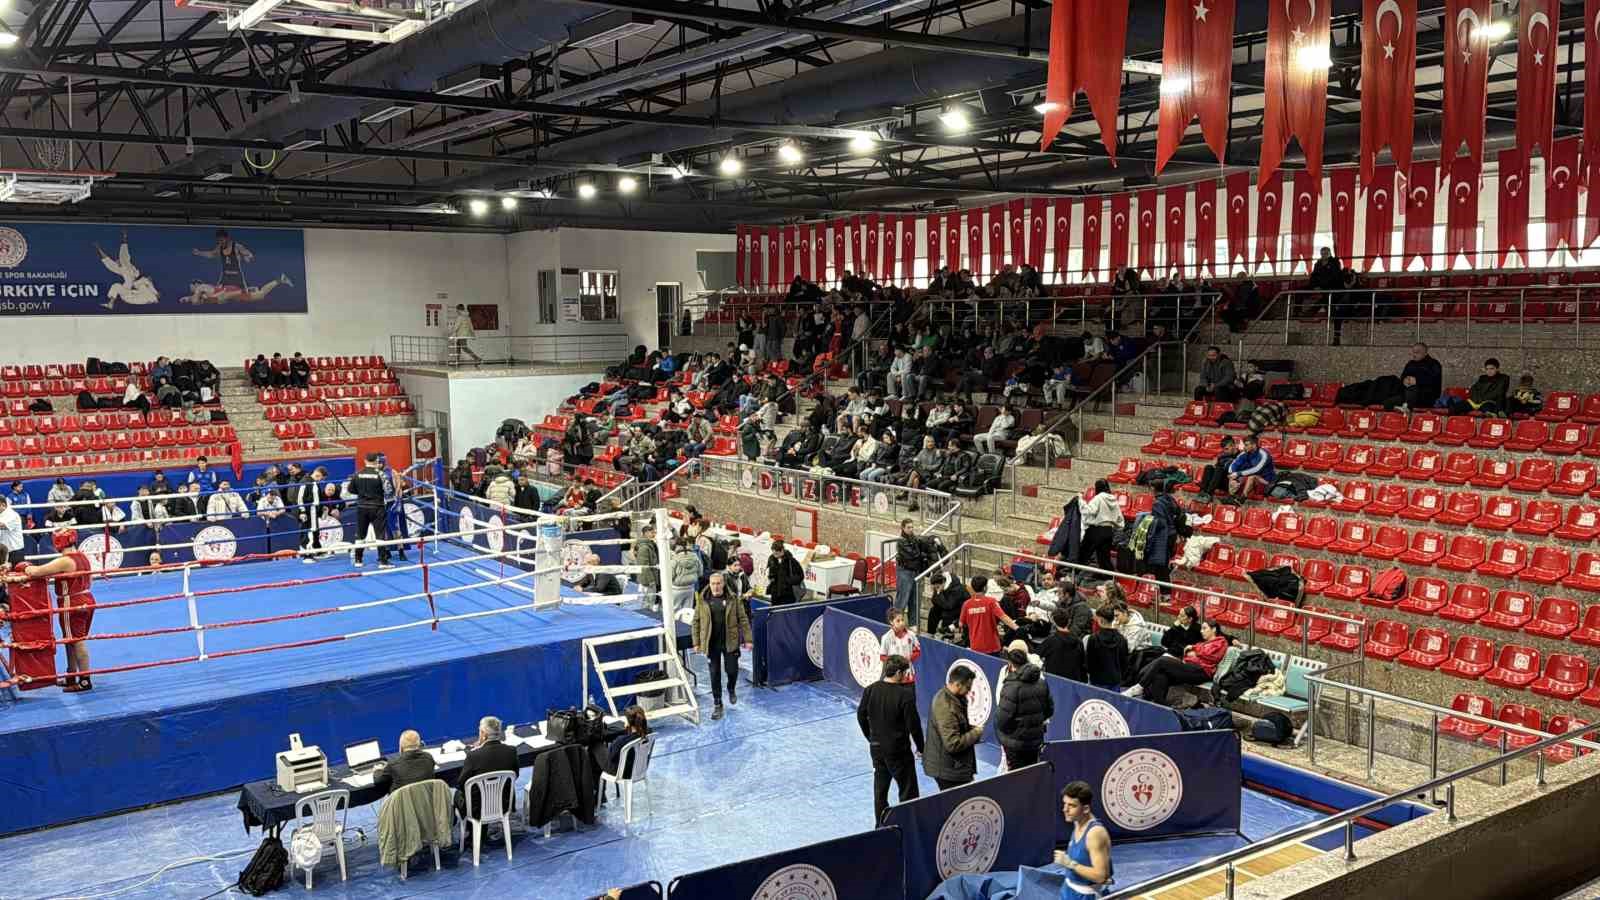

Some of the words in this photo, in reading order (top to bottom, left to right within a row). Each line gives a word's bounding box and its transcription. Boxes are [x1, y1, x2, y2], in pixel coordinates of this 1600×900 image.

[4, 271, 25, 279] SPOR
[0, 284, 56, 297] RKİYE
[61, 284, 99, 298] İÇİN
[0, 299, 52, 313] sb.gov.tr
